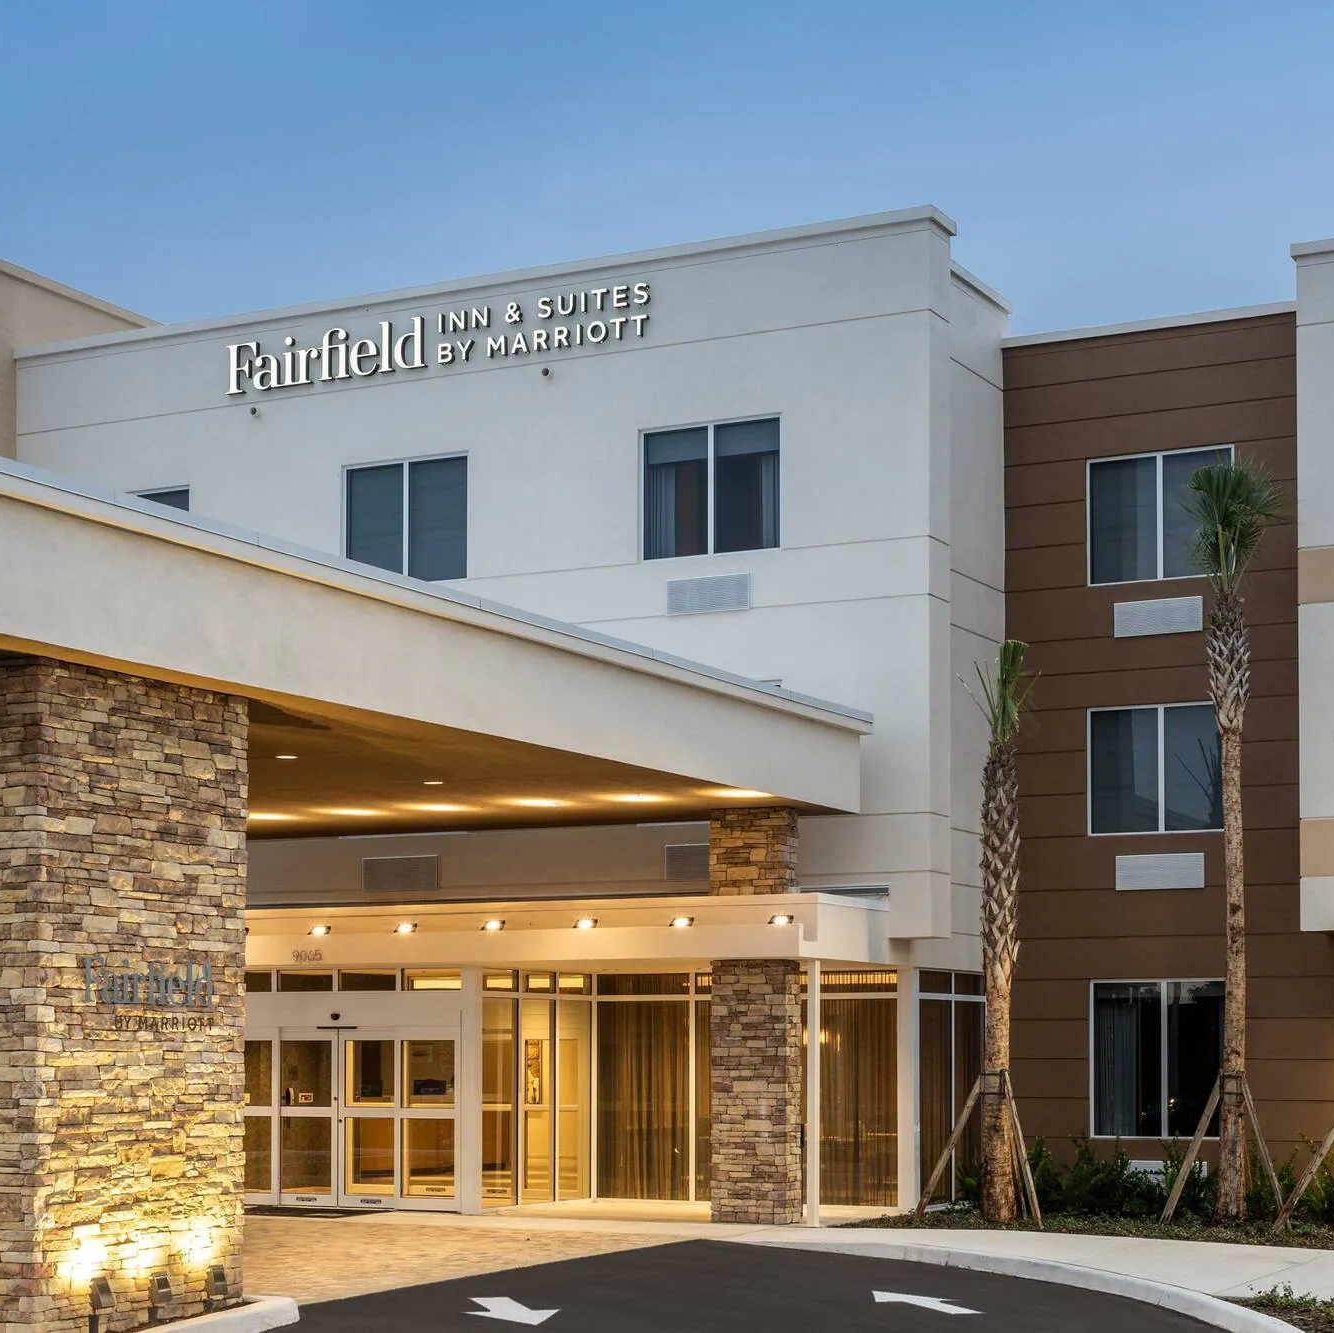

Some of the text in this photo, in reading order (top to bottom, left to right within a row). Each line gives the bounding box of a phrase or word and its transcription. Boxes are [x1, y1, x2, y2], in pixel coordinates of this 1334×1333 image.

[438, 282, 650, 334] INN & SUITES
[226, 316, 427, 395] Fairfield
[437, 314, 650, 365] BY MARRIOTT
[82, 955, 214, 1008] Fairfield
[115, 1015, 214, 1031] BY MARRIOTT
